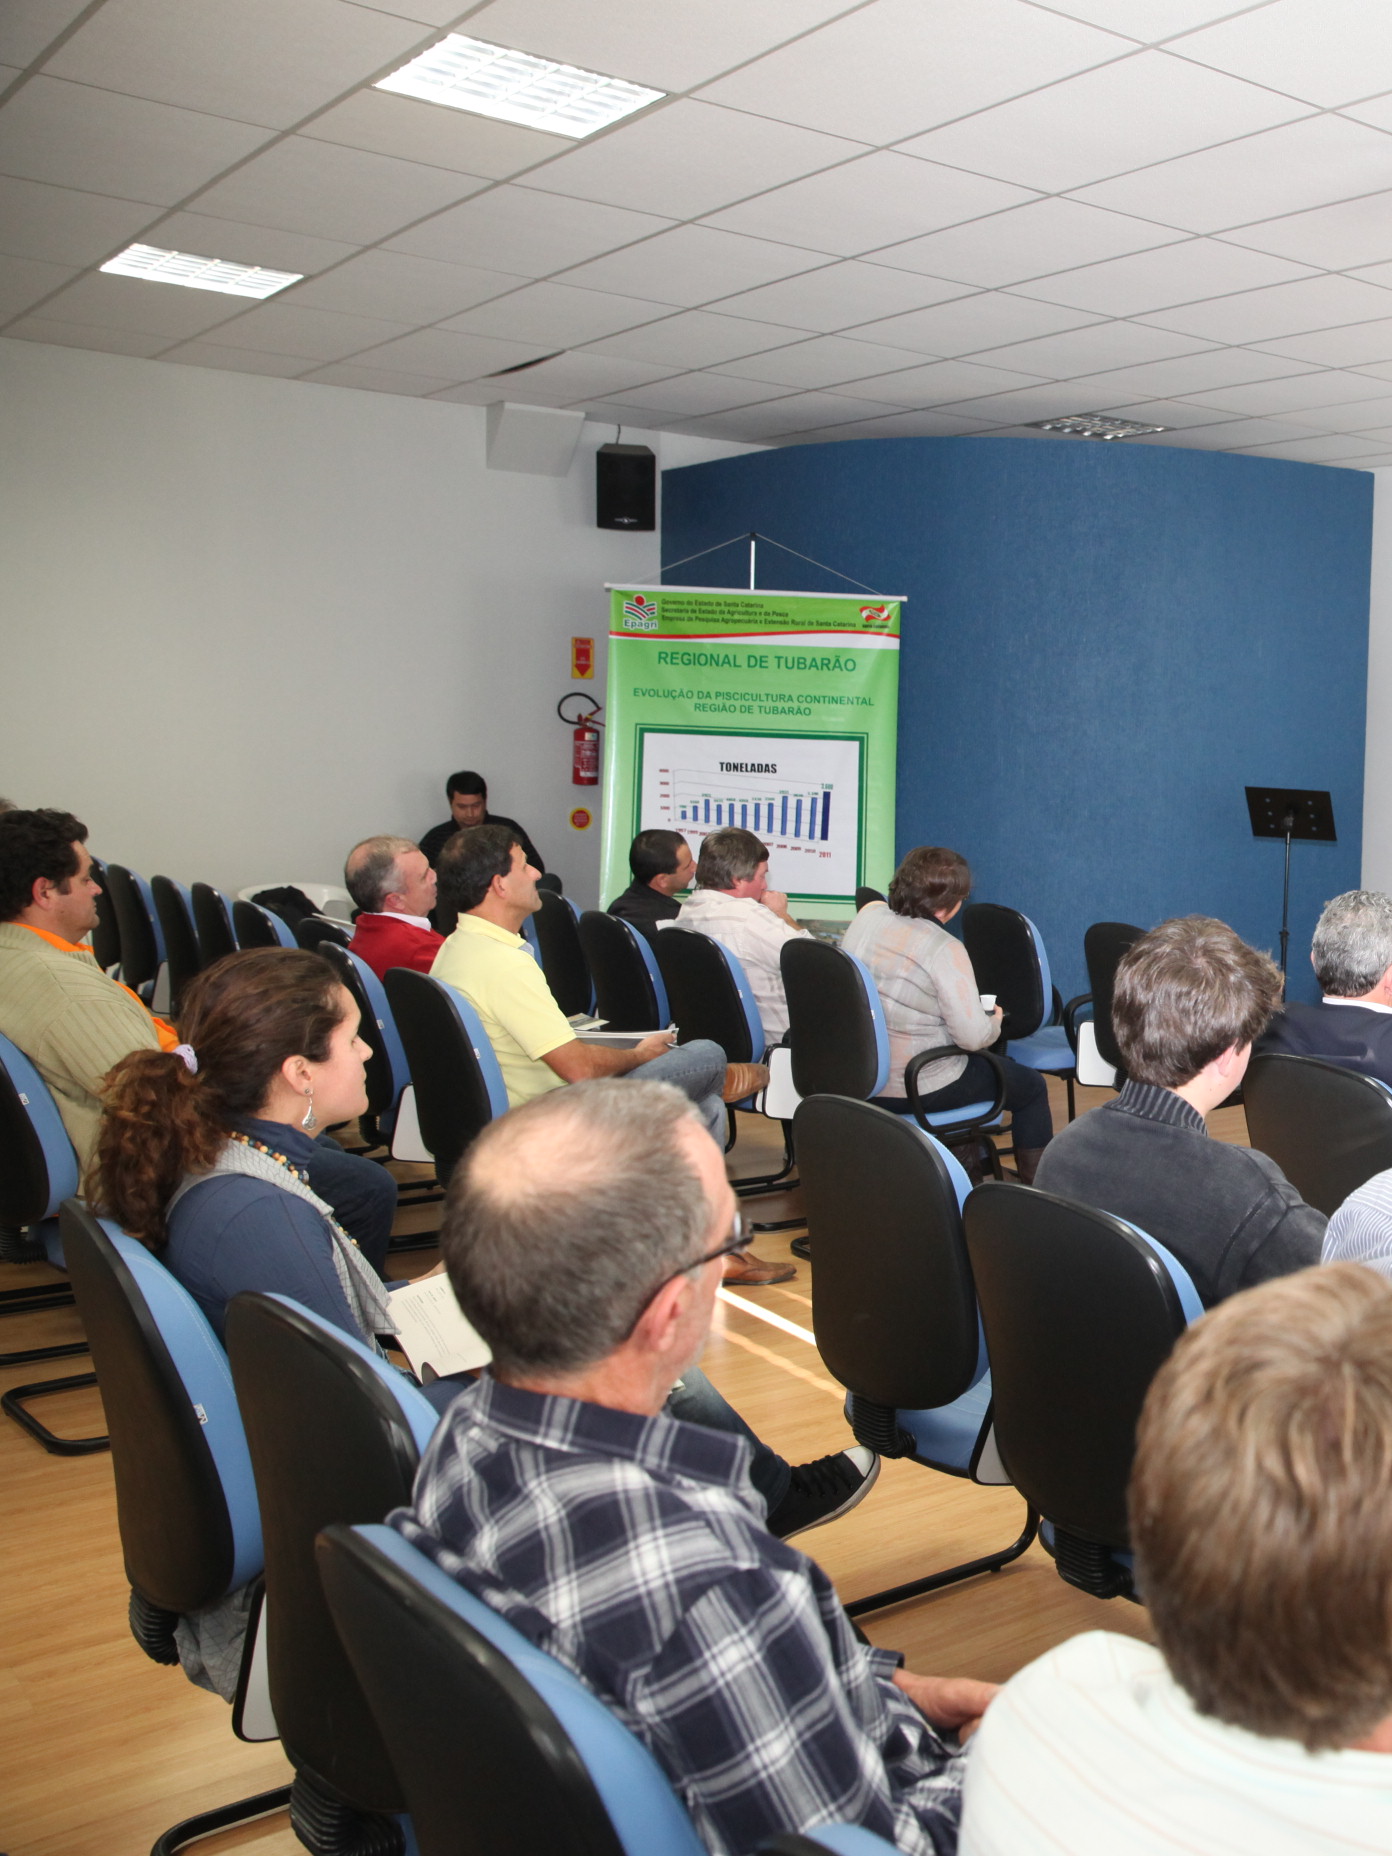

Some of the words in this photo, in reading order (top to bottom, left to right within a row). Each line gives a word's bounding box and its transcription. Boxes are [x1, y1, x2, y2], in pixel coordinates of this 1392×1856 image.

[624, 620, 657, 629] Epagri
[658, 651, 742, 668] REGIONAL
[747, 655, 768, 668] DE
[774, 654, 856, 672] TUBARÃO
[633, 687, 694, 700] EVOLUÇÃO
[697, 690, 712, 700] DA
[715, 691, 794, 702] PISCICULTURA
[797, 694, 874, 707] CONTINENTAL
[694, 702, 736, 713] REGIÃO
[740, 705, 753, 714] DE
[757, 704, 812, 716] TUBARÃO
[719, 762, 777, 774] TONELADAS
